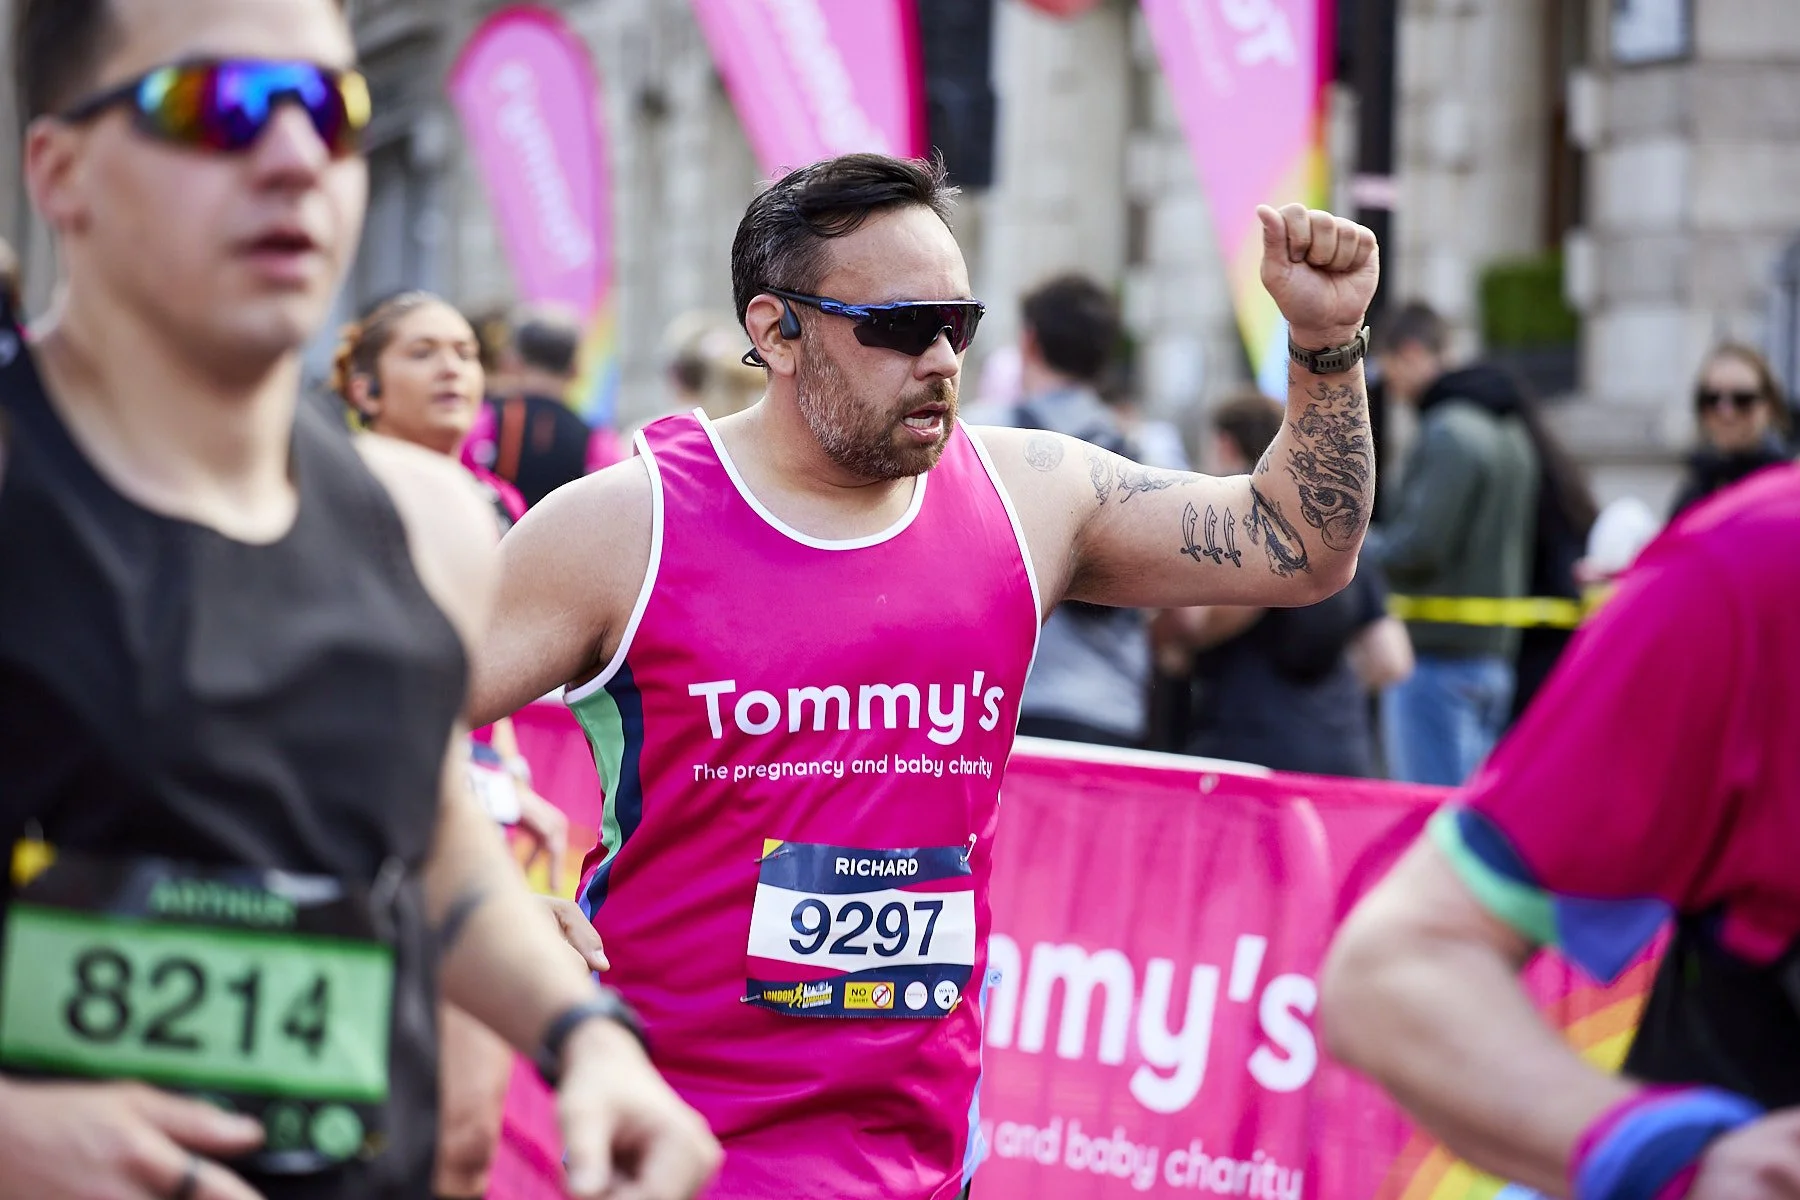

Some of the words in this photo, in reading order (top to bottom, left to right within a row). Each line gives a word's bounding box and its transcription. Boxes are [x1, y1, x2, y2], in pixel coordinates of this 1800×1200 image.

[688, 671, 1004, 745] Tommy's
[693, 765, 727, 781] The
[733, 759, 844, 782] pregnancy
[852, 754, 888, 775] and
[894, 754, 944, 778] baby
[949, 755, 993, 779] charity
[835, 857, 918, 876] RICHARD
[789, 898, 943, 957] 9297
[64, 945, 331, 1058] 8214
[763, 989, 794, 1003] LONDON
[851, 988, 867, 997] NO
[943, 994, 950, 1004] 4
[994, 1115, 1063, 1166] and
[1064, 1117, 1160, 1192] baby
[1164, 1138, 1304, 1200] charity
